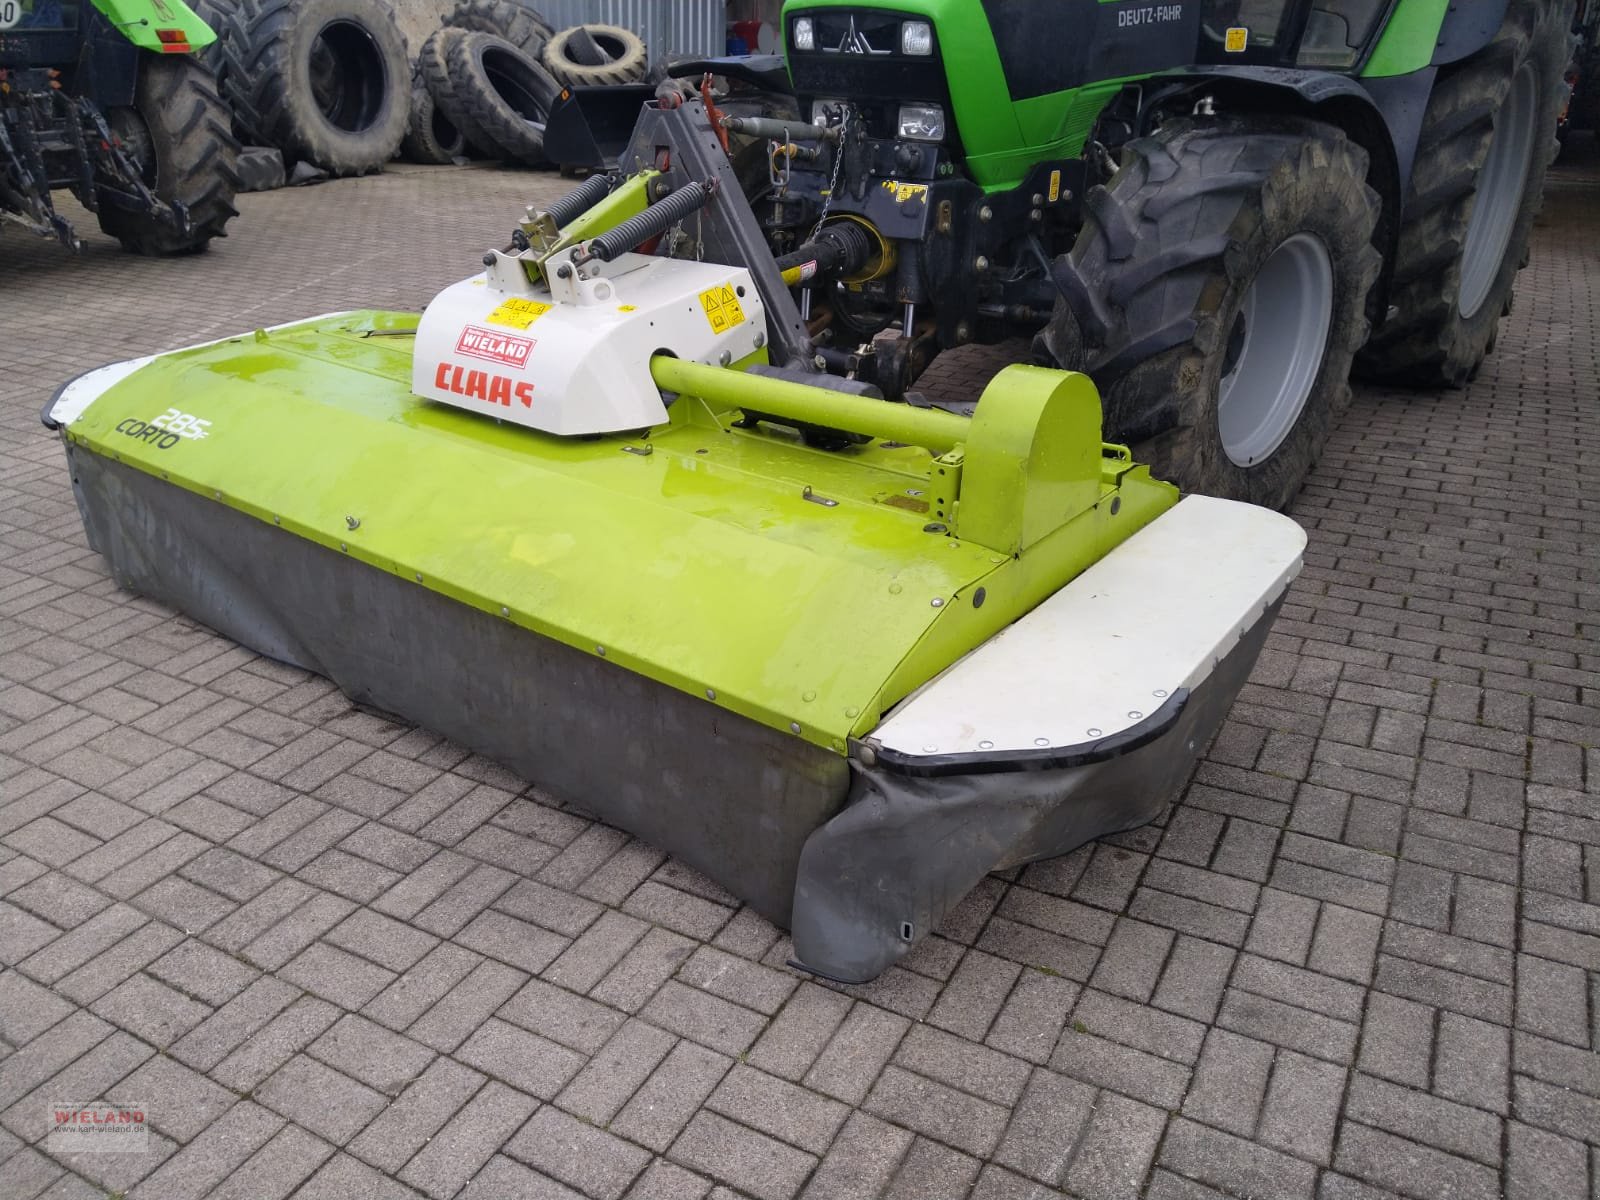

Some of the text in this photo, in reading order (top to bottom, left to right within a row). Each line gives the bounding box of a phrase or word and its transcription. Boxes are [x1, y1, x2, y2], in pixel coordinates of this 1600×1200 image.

[0, 2, 14, 23] 0
[463, 333, 527, 358] WIELAND
[435, 362, 535, 408] CLAAS
[115, 418, 180, 449] CORTO
